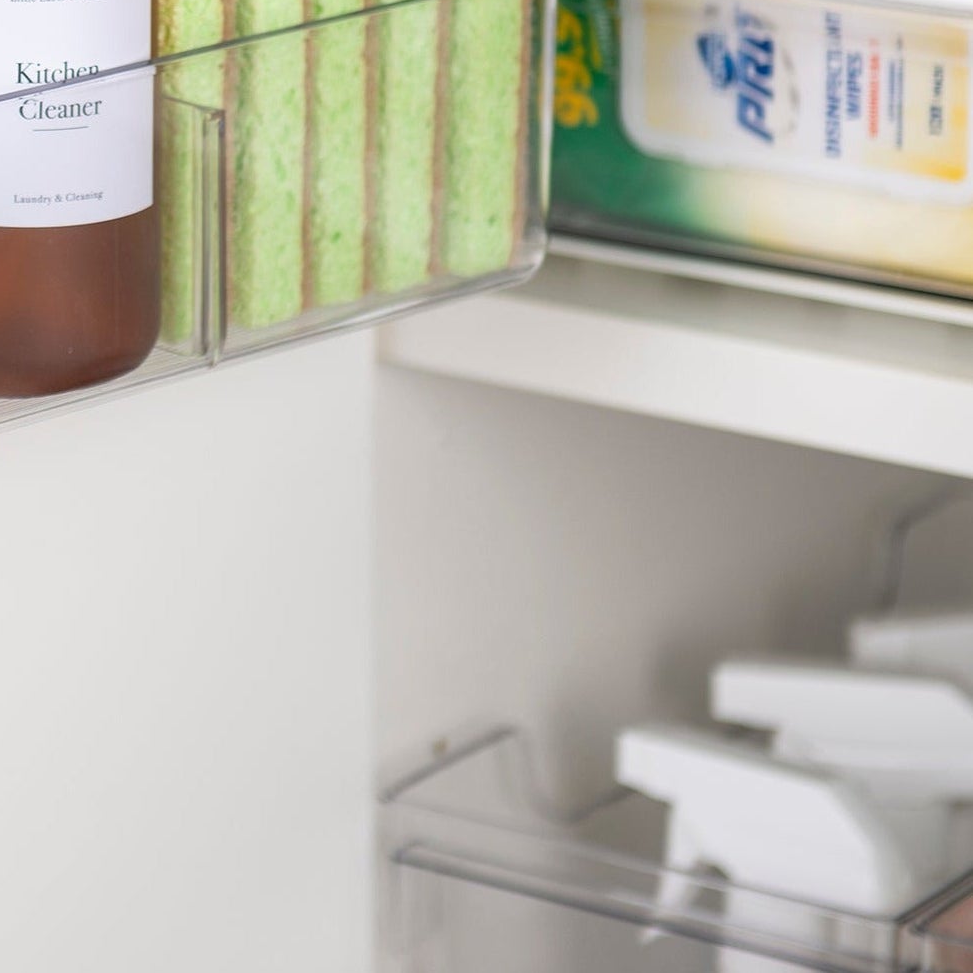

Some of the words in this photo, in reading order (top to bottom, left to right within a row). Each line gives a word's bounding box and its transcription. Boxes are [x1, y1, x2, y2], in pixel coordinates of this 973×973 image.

[15, 61, 100, 85] Kitchen
[18, 99, 103, 121] Cleaner
[13, 193, 52, 206] Laundry
[54, 192, 63, 203] &
[65, 190, 104, 203] Cleaning
